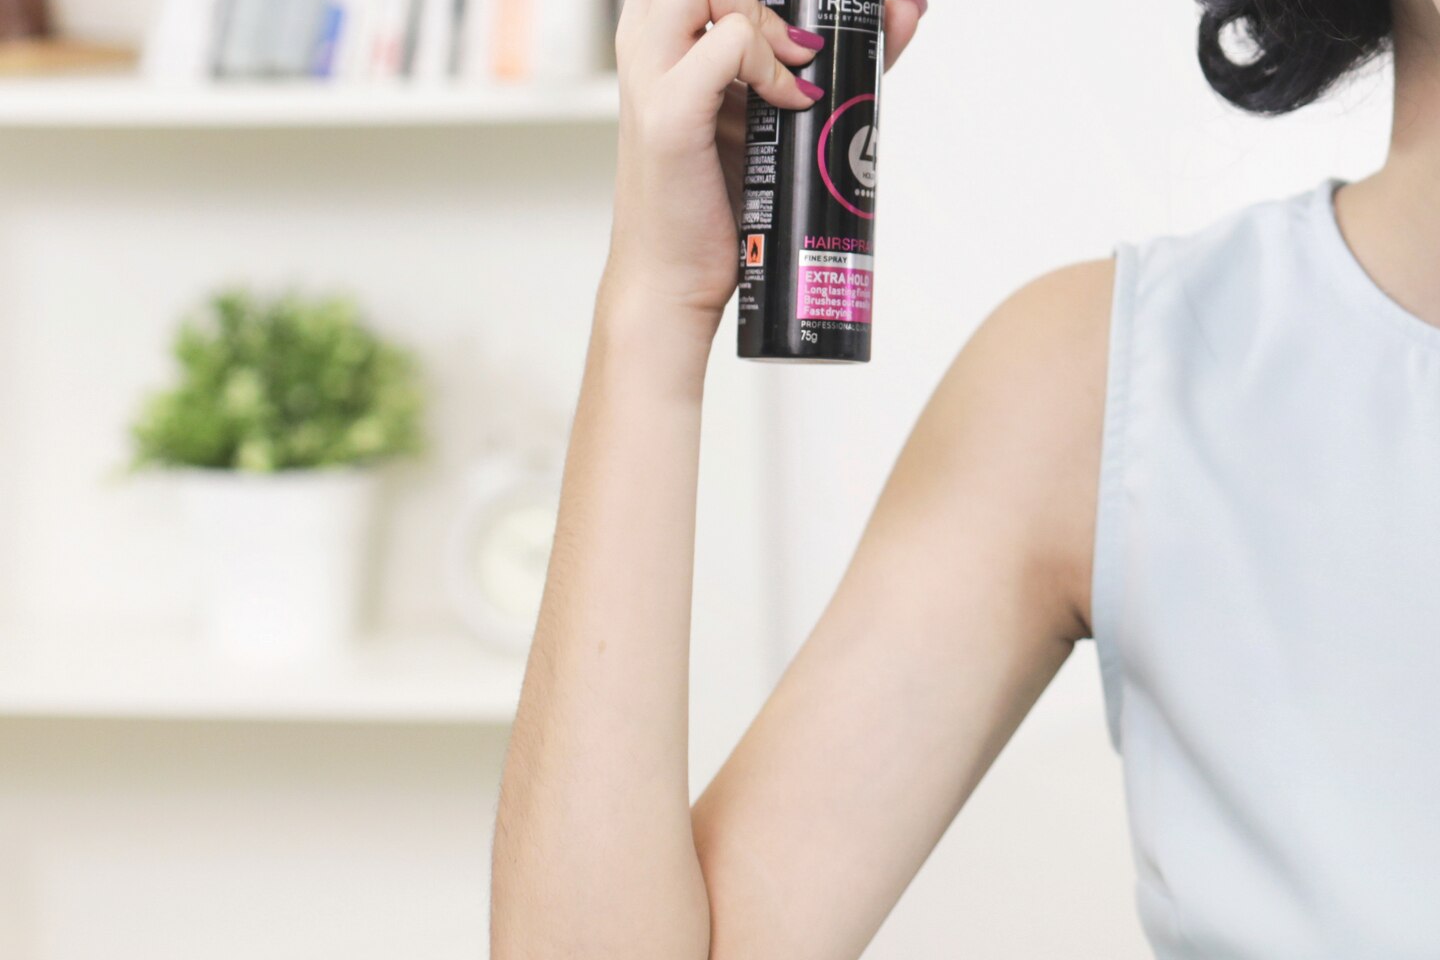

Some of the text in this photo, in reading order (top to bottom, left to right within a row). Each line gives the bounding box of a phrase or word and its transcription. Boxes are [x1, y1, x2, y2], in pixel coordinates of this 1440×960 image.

[804, 254, 848, 264] FINE SPRAY
[805, 271, 871, 287] EXTRA HOLD
[804, 285, 828, 297] Long
[828, 286, 857, 299] lasting
[804, 295, 842, 307] Brushes
[842, 299, 855, 307] out
[803, 306, 853, 321] Fast drying
[800, 329, 818, 344] 75g
